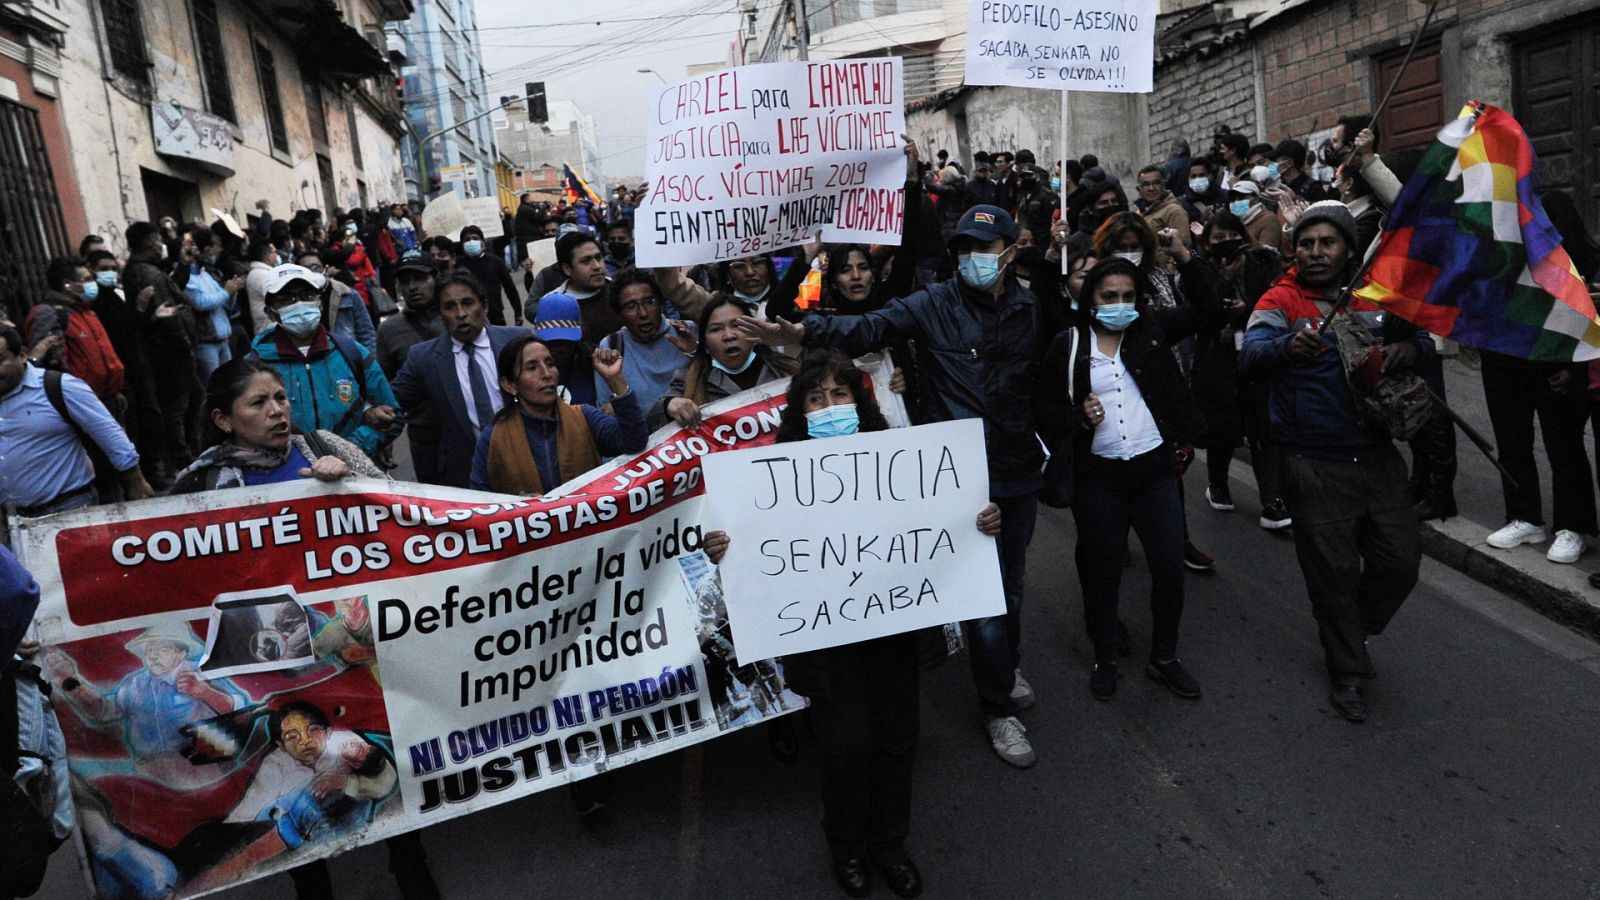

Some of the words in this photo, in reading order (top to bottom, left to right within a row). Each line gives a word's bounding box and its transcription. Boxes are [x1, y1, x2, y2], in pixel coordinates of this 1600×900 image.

[1025, 66, 1046, 79] SE
[1059, 66, 1126, 88] OLVIDA!!!
[1101, 46, 1120, 62] NO
[659, 71, 747, 126] CARCEL
[751, 89, 791, 120] para
[807, 61, 893, 108] CAMACHO
[653, 121, 741, 163] JUSTICIA
[742, 140, 770, 167] para
[778, 117, 809, 154] LAS
[817, 109, 896, 152] VÍCTIMAS
[650, 175, 713, 205] ASOC.
[720, 163, 814, 198] VÍCTIMAS
[825, 161, 868, 187] 2019
[112, 507, 302, 567] COMITÉ
[713, 403, 789, 446] CON
[752, 446, 960, 510] JUSTICIA
[304, 541, 391, 581] LOS
[403, 495, 618, 565] GOLPISTAS
[627, 479, 665, 513] DE
[760, 528, 955, 576] SENKATA
[377, 565, 583, 643] Defender
[595, 547, 625, 585] la
[640, 517, 705, 571] vida
[778, 578, 939, 637] SACABA
[474, 597, 596, 663] contra
[613, 580, 644, 619] la
[460, 607, 668, 708] Impunidad
[409, 737, 446, 777] NI
[447, 704, 550, 764] OLVIDO
[553, 693, 587, 730] NI
[587, 664, 699, 721] PERDÓN
[419, 698, 706, 813] JUSTICIA!!!
